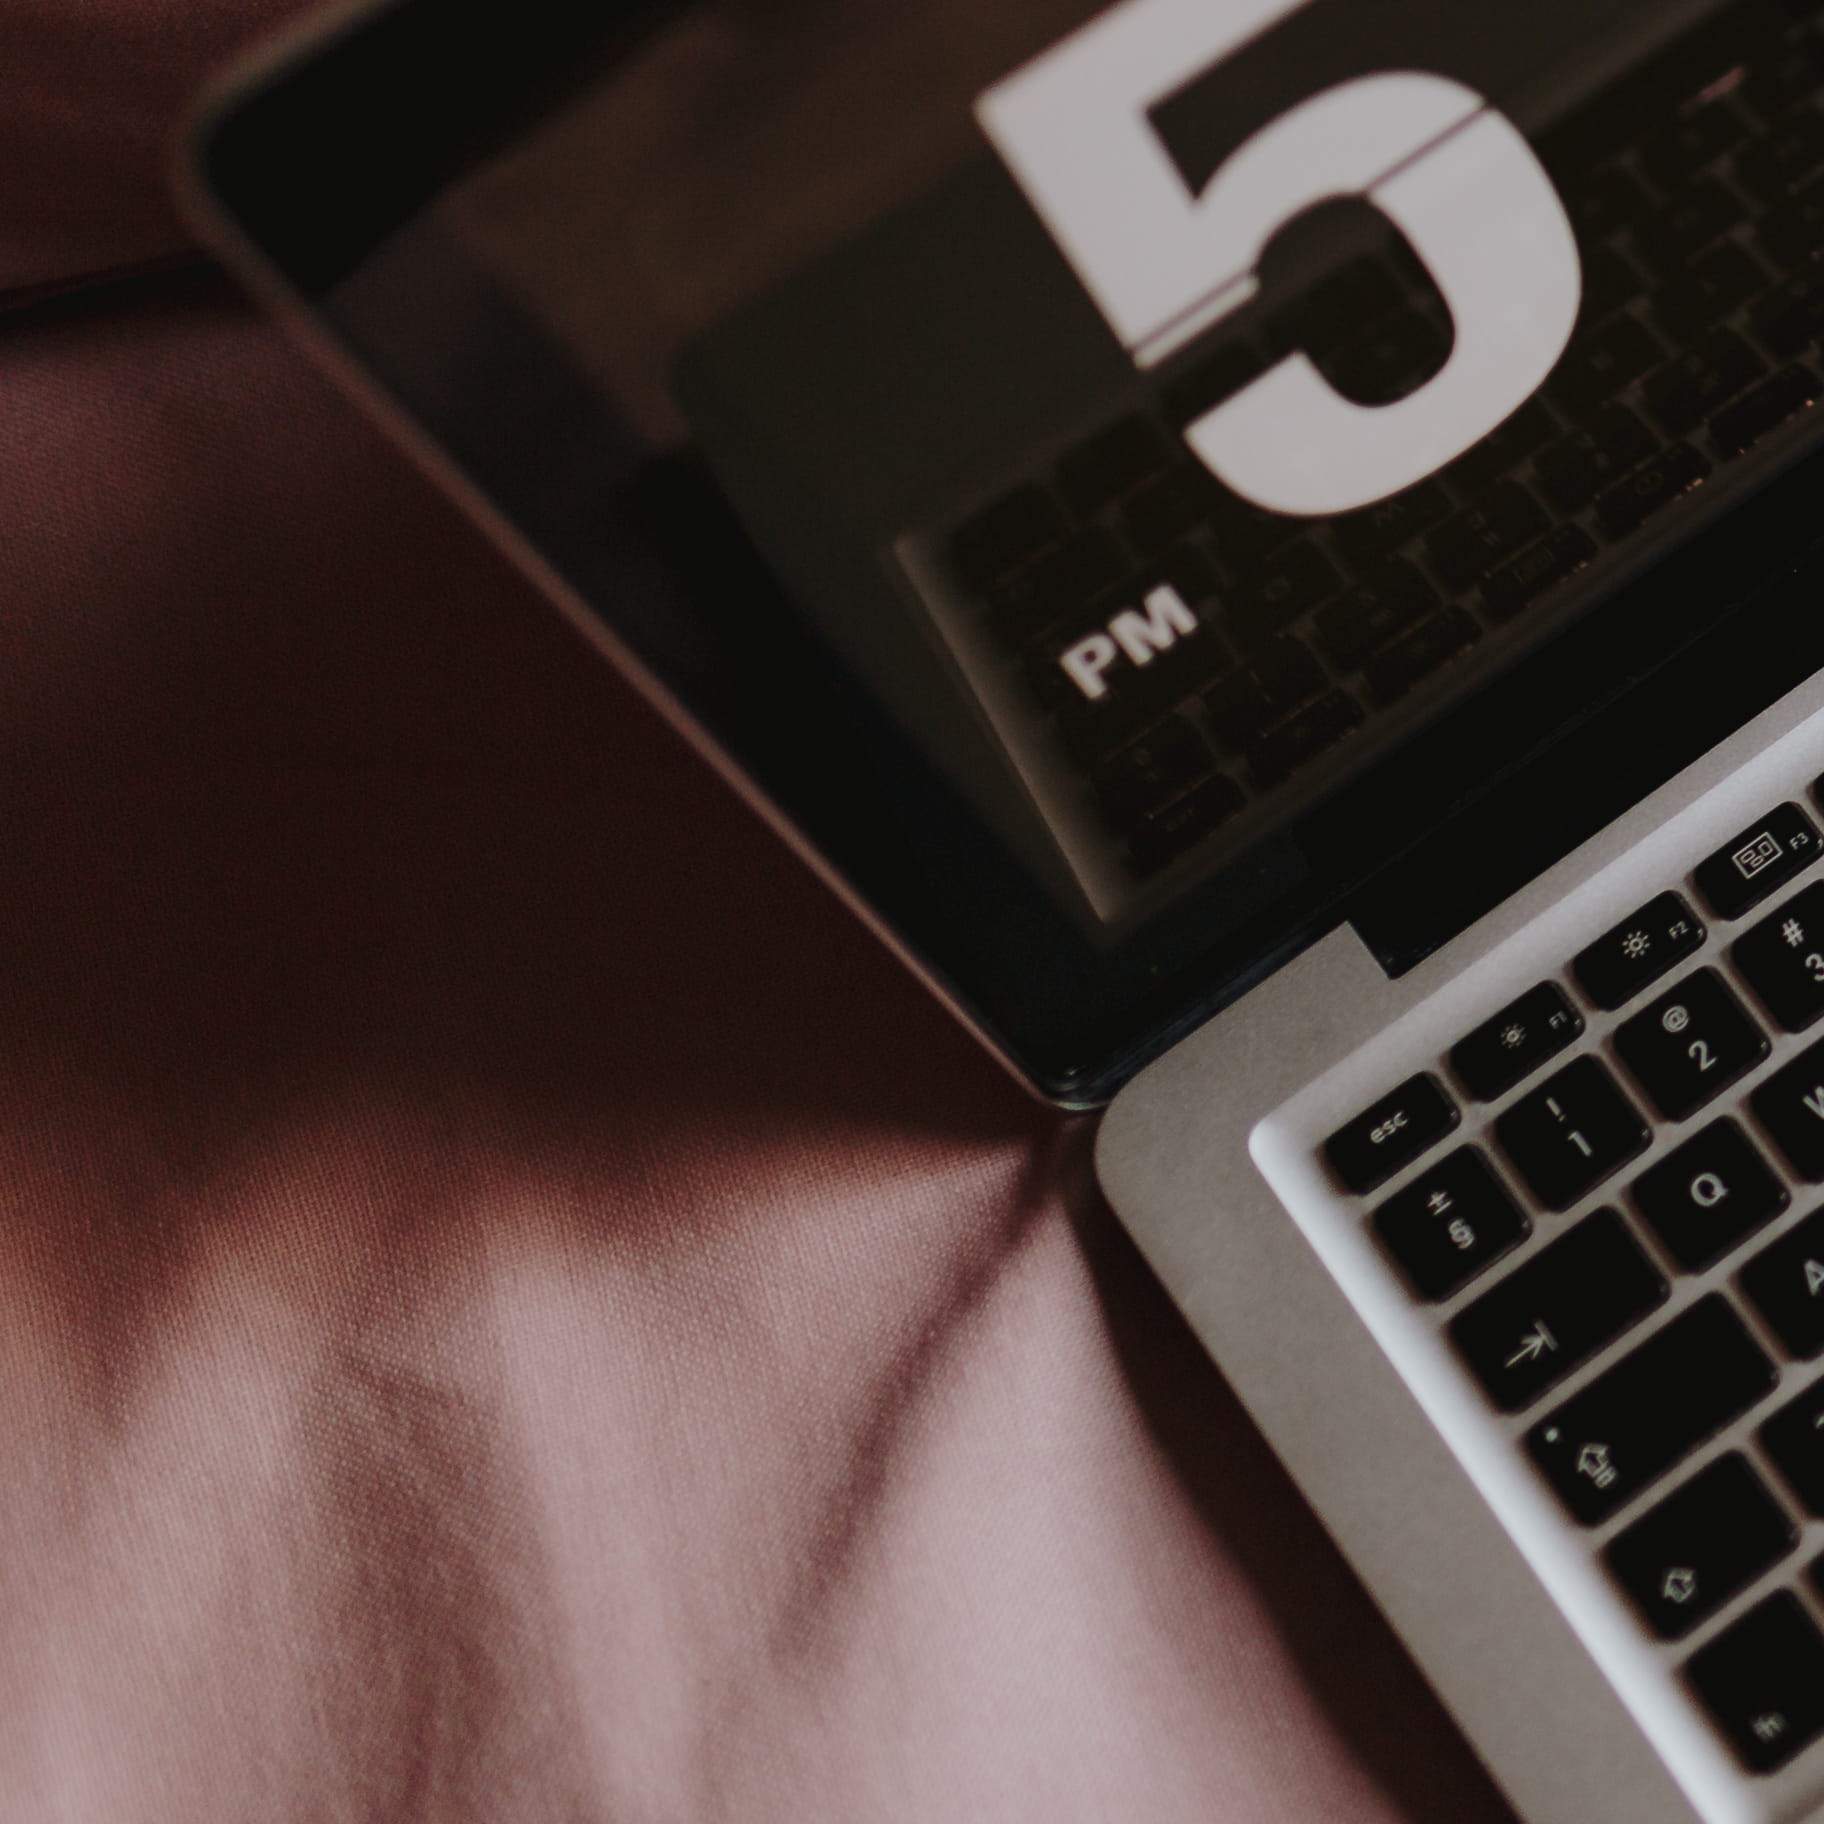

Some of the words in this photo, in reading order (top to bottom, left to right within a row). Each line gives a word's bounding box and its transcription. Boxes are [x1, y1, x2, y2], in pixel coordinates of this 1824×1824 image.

[1060, 583, 1198, 701] PM
[1789, 832, 1809, 850] F3
[1668, 920, 1689, 940] F2
[1782, 918, 1804, 947] #
[1661, 1004, 1690, 1033] @
[1688, 1039, 1718, 1072] 2
[1369, 1110, 1408, 1145] esc
[1567, 1130, 1593, 1157] 1
[1690, 1172, 1728, 1207] Q
